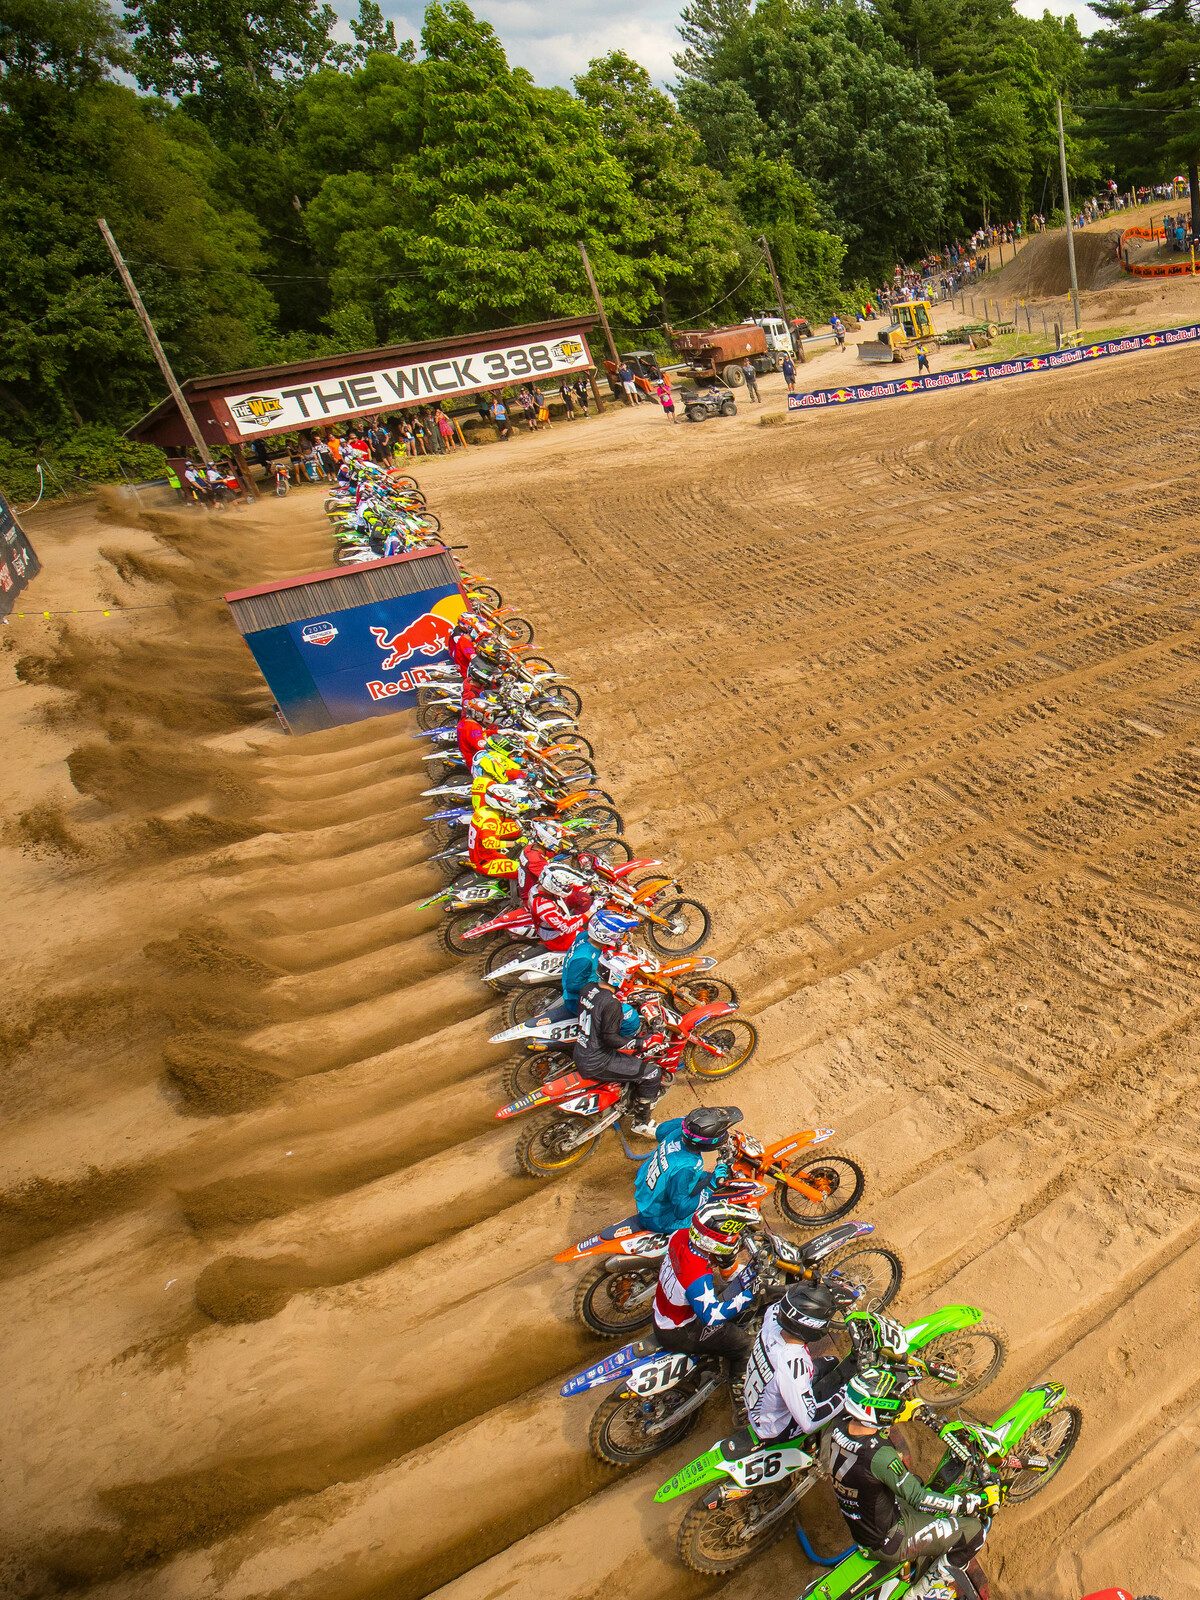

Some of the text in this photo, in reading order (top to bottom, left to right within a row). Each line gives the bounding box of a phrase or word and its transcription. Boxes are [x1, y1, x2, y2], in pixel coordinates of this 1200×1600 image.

[281, 345, 552, 418] THE WICK 338
[232, 406, 252, 418] THE
[308, 624, 328, 634] 2019
[366, 670, 414, 700] Red
[466, 888, 490, 900] 88
[550, 1024, 580, 1040] 813
[574, 1093, 600, 1112] 41
[638, 1356, 689, 1393] 314
[744, 1452, 782, 1486] 56
[830, 1442, 858, 1482] 17
[678, 1474, 707, 1492] DUNLOP
